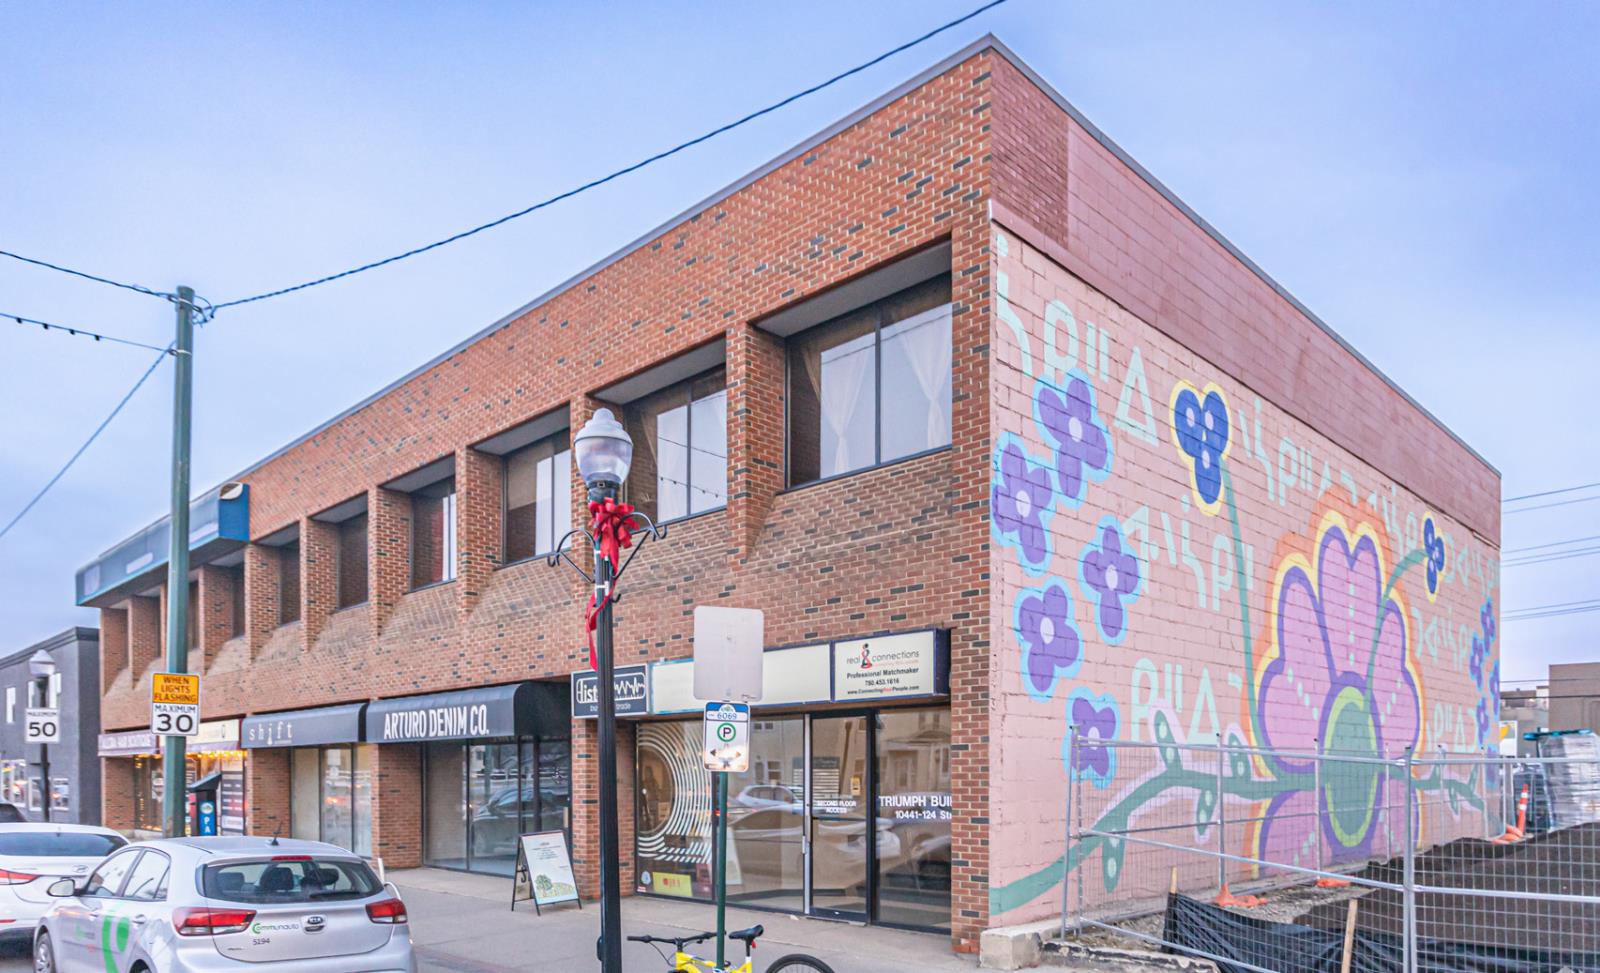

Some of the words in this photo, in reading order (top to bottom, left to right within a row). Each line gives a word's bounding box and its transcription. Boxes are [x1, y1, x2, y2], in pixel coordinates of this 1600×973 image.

[846, 656, 860, 664] real
[872, 649, 919, 662] connections
[846, 671, 881, 679] Professional
[883, 667, 919, 676] Matchmaker
[163, 676, 190, 684] WHEN
[161, 684, 191, 694] LIGHTS
[154, 693, 197, 703] FLASHING
[154, 704, 196, 713] MAXIMUM
[717, 712, 737, 720] 6069
[156, 713, 193, 732] 30
[383, 710, 427, 740] ARTURO
[429, 706, 467, 737] DENIM
[470, 704, 489, 736] CO.
[29, 721, 56, 737] 50
[249, 720, 293, 745] shift
[722, 727, 732, 738] P
[879, 795, 927, 808] TRIUMPH
[895, 810, 936, 820] 10441-124
[252, 923, 300, 934] Communauto
[252, 938, 271, 946] 5194
